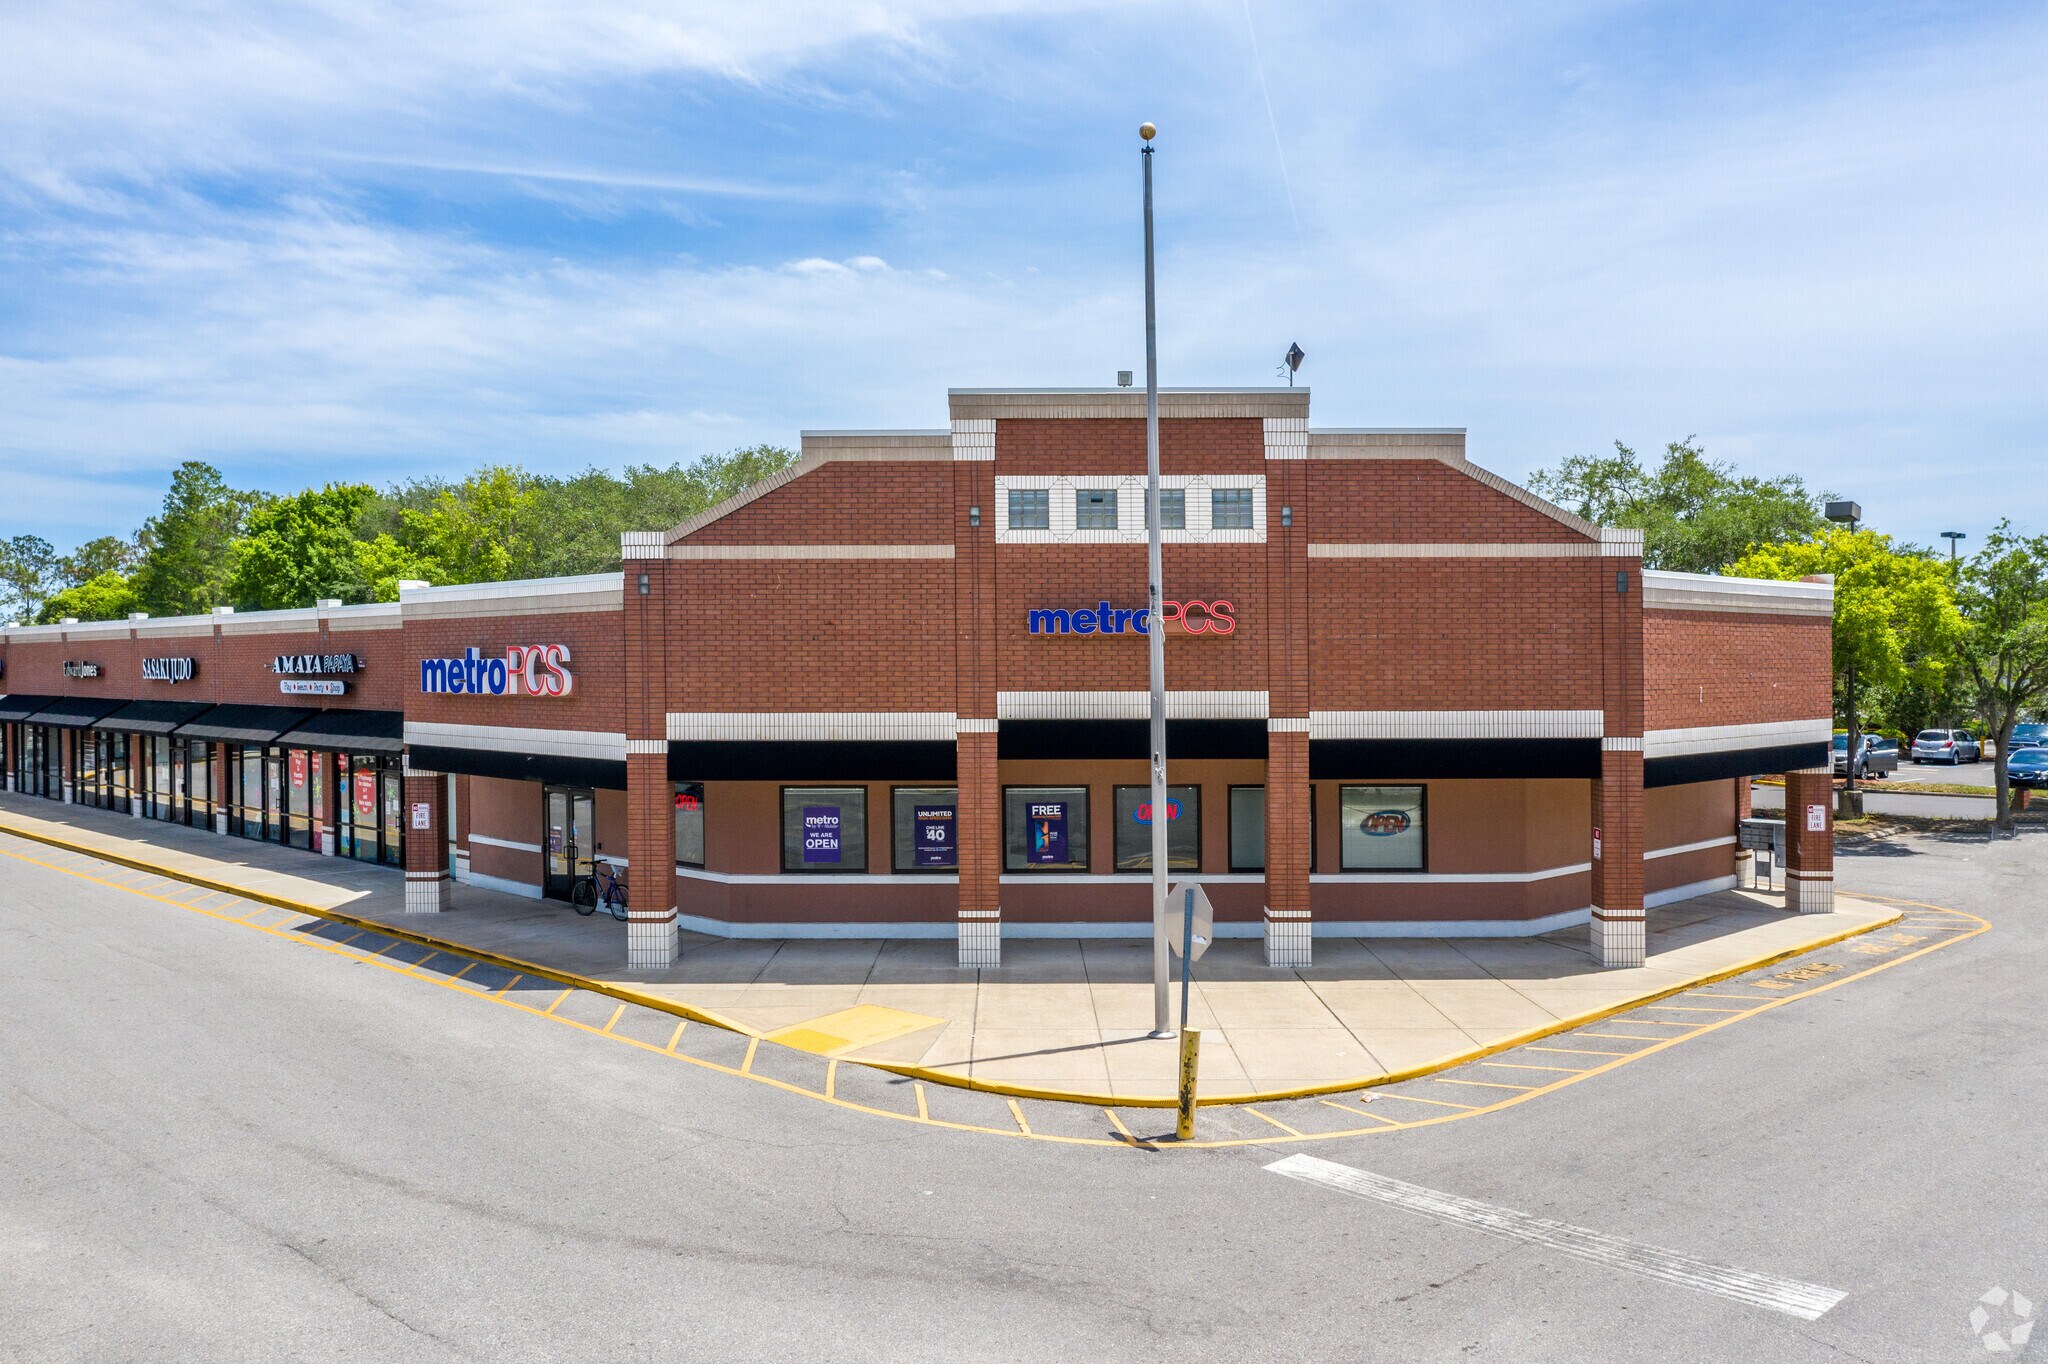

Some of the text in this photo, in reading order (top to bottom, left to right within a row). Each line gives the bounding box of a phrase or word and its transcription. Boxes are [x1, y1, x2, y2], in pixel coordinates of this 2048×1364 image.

[81, 661, 98, 678] Jones
[143, 658, 192, 684] SASAKI JUDO
[272, 653, 354, 673] AMAYA PAPAYA
[421, 644, 571, 696] metroPCS
[675, 794, 699, 811] OPEN
[1032, 805, 1061, 815] FREE
[414, 819, 427, 827] LANE
[806, 815, 839, 824] metro
[1365, 815, 1405, 833] OPEN
[806, 839, 839, 848] OPEN
[926, 829, 945, 841] $40
